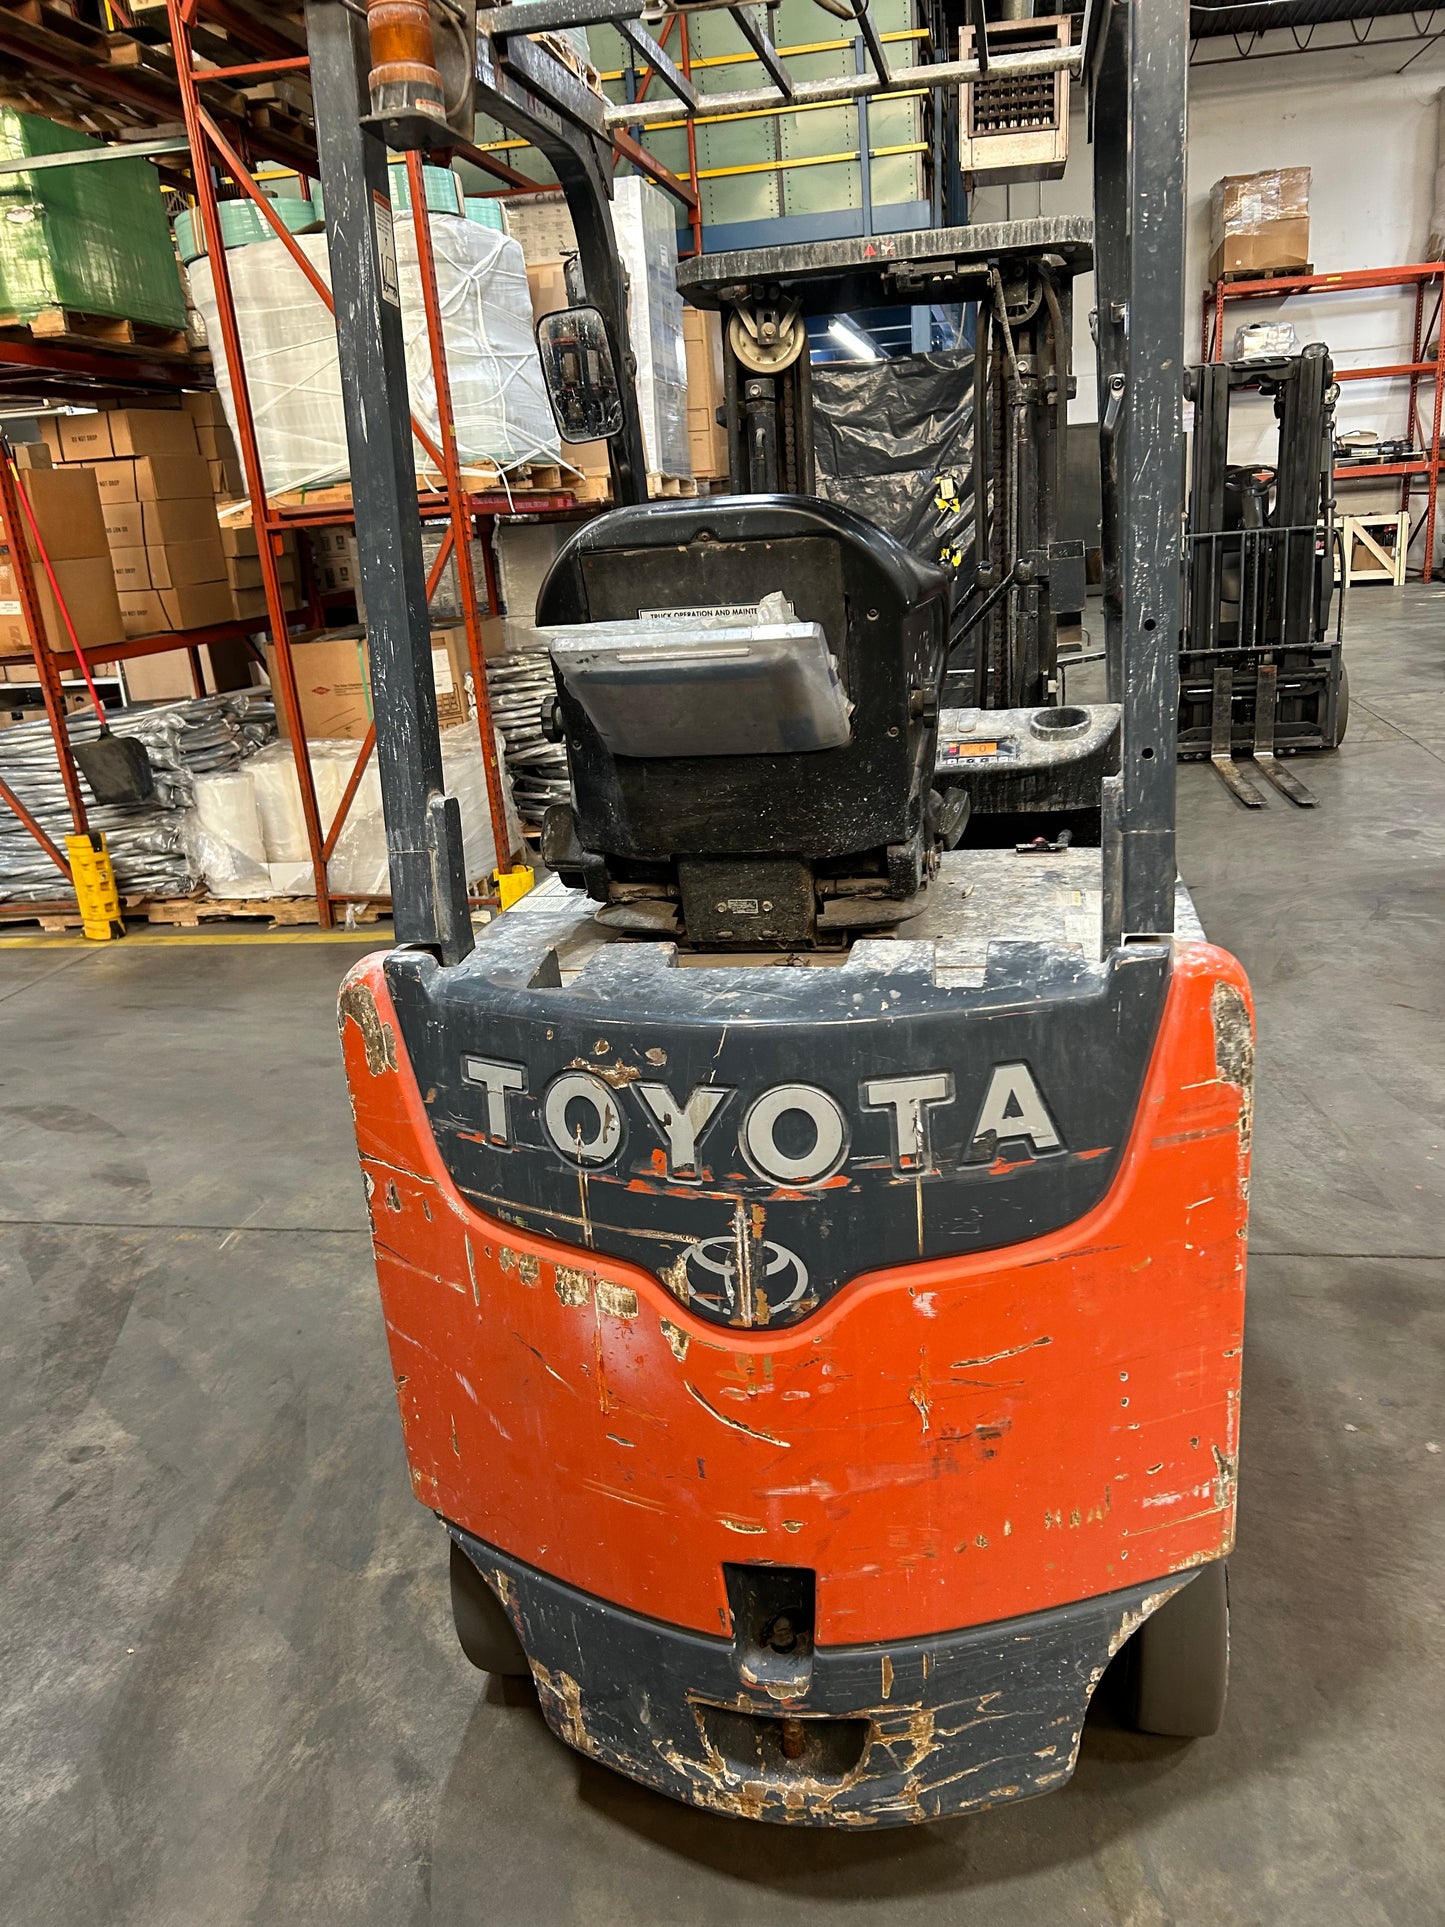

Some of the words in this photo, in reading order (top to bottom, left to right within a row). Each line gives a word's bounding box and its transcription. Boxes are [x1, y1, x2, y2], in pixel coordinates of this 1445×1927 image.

[673, 610, 713, 618] OPERATION
[715, 609, 731, 617] AND
[732, 607, 758, 616] MAINTE
[463, 1060, 1065, 1185] TOYOTA
